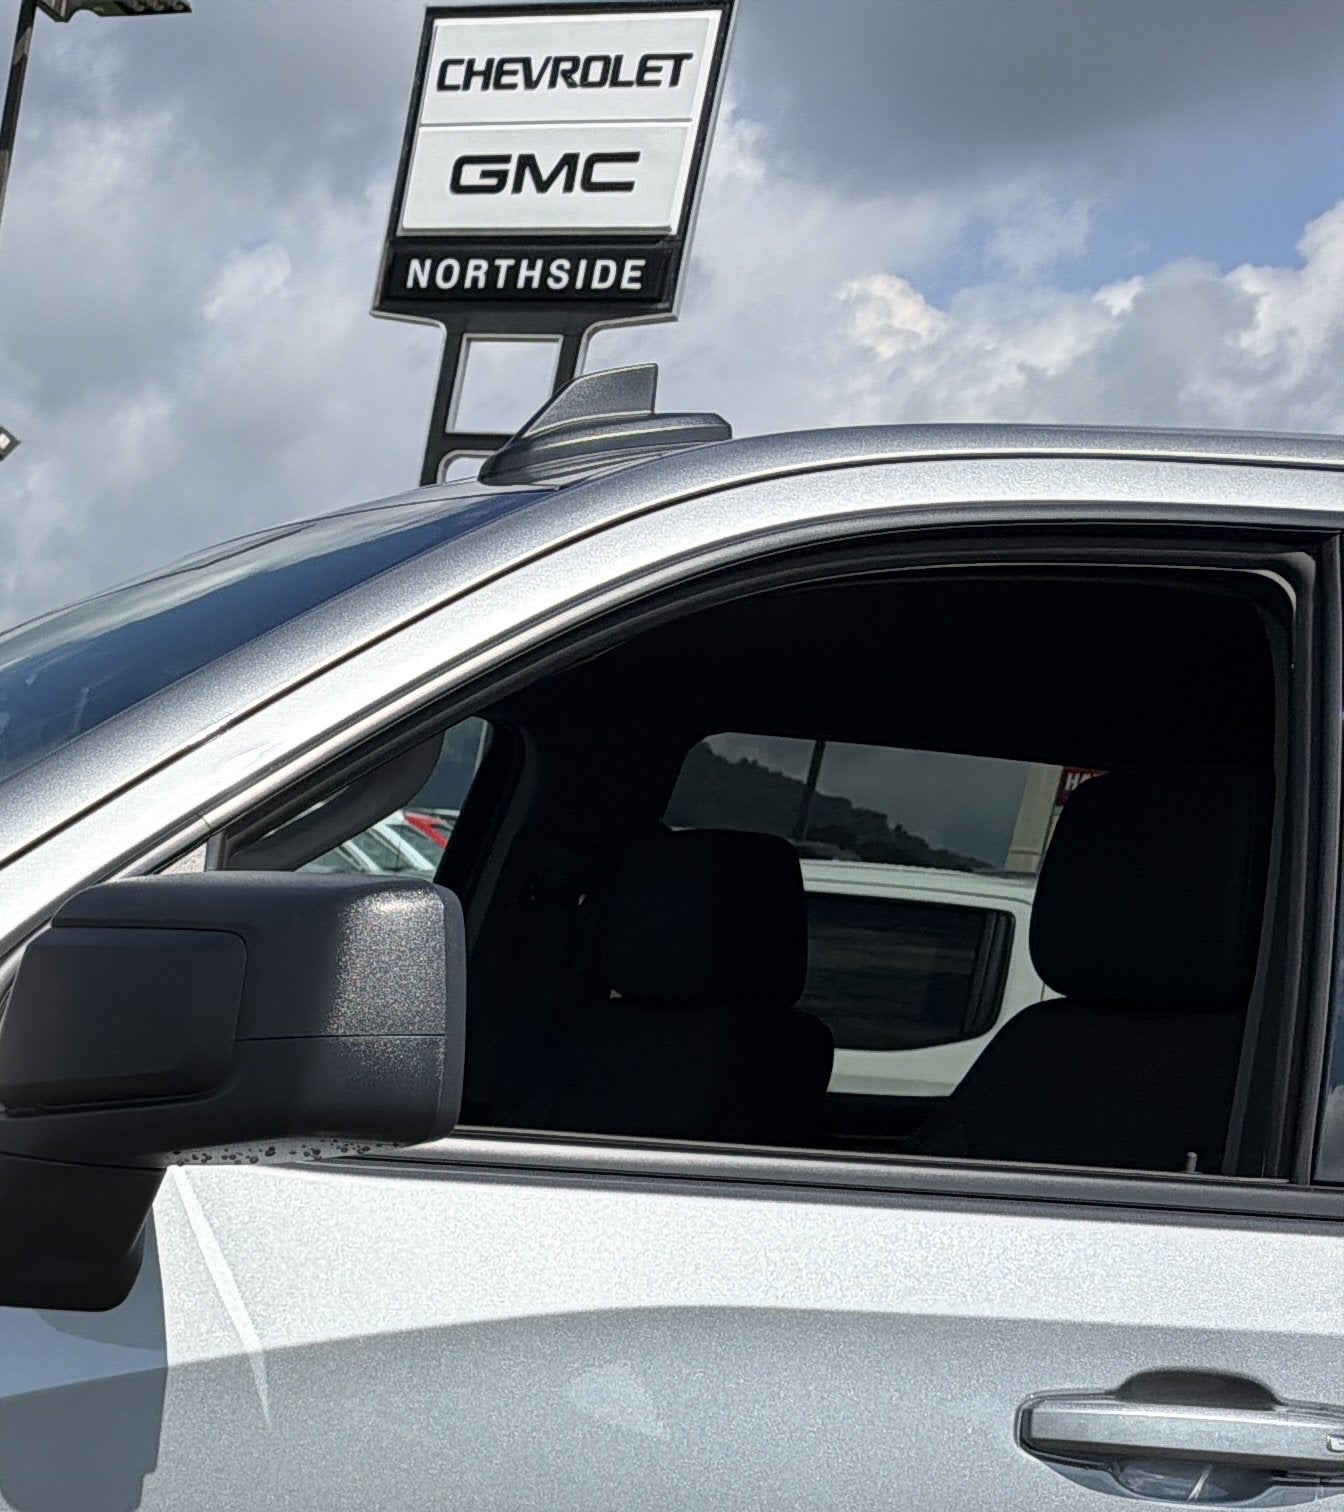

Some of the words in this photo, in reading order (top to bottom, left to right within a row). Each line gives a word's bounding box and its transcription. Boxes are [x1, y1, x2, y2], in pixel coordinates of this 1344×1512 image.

[436, 52, 694, 92] CHEVROLET
[449, 151, 641, 195] GMC
[406, 258, 647, 290] NORTHSIDE
